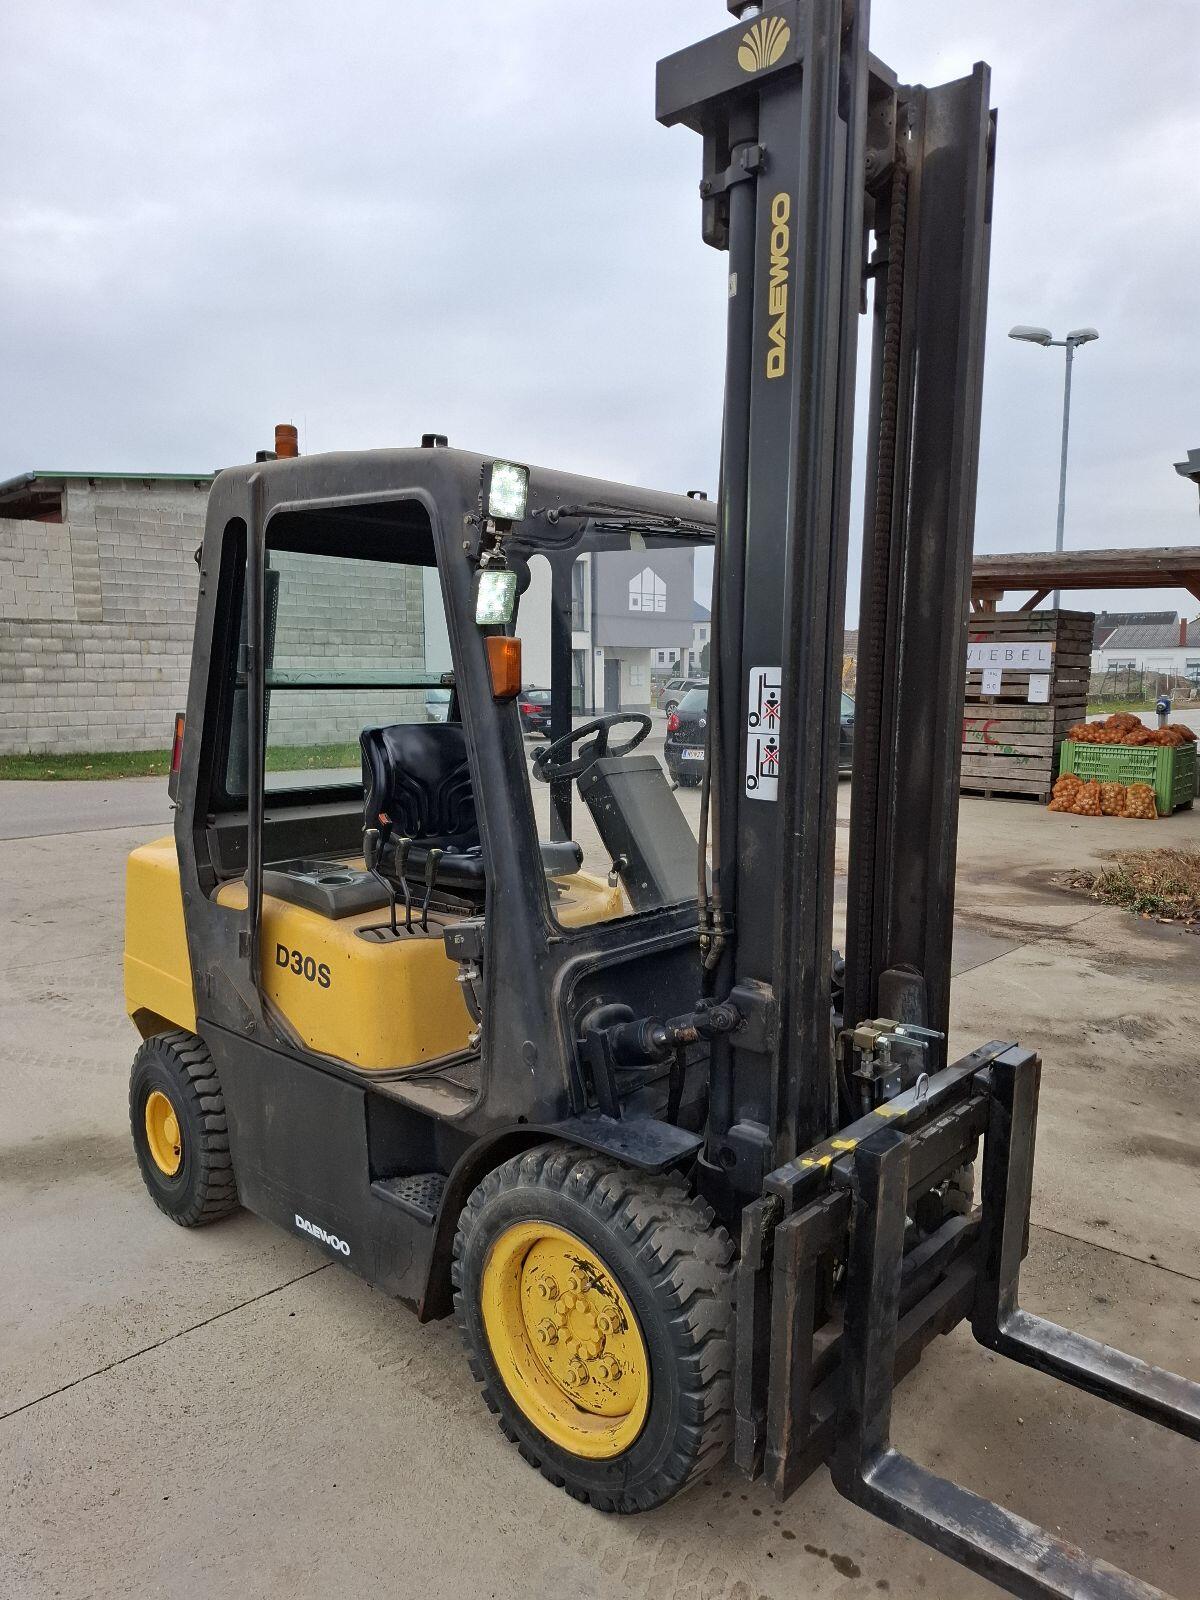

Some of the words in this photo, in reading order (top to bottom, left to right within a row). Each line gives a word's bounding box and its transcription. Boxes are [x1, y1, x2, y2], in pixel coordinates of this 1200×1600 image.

[766, 192, 791, 379] DAEWOO
[275, 942, 331, 989] D30S
[294, 1213, 351, 1256] DAEWOO
